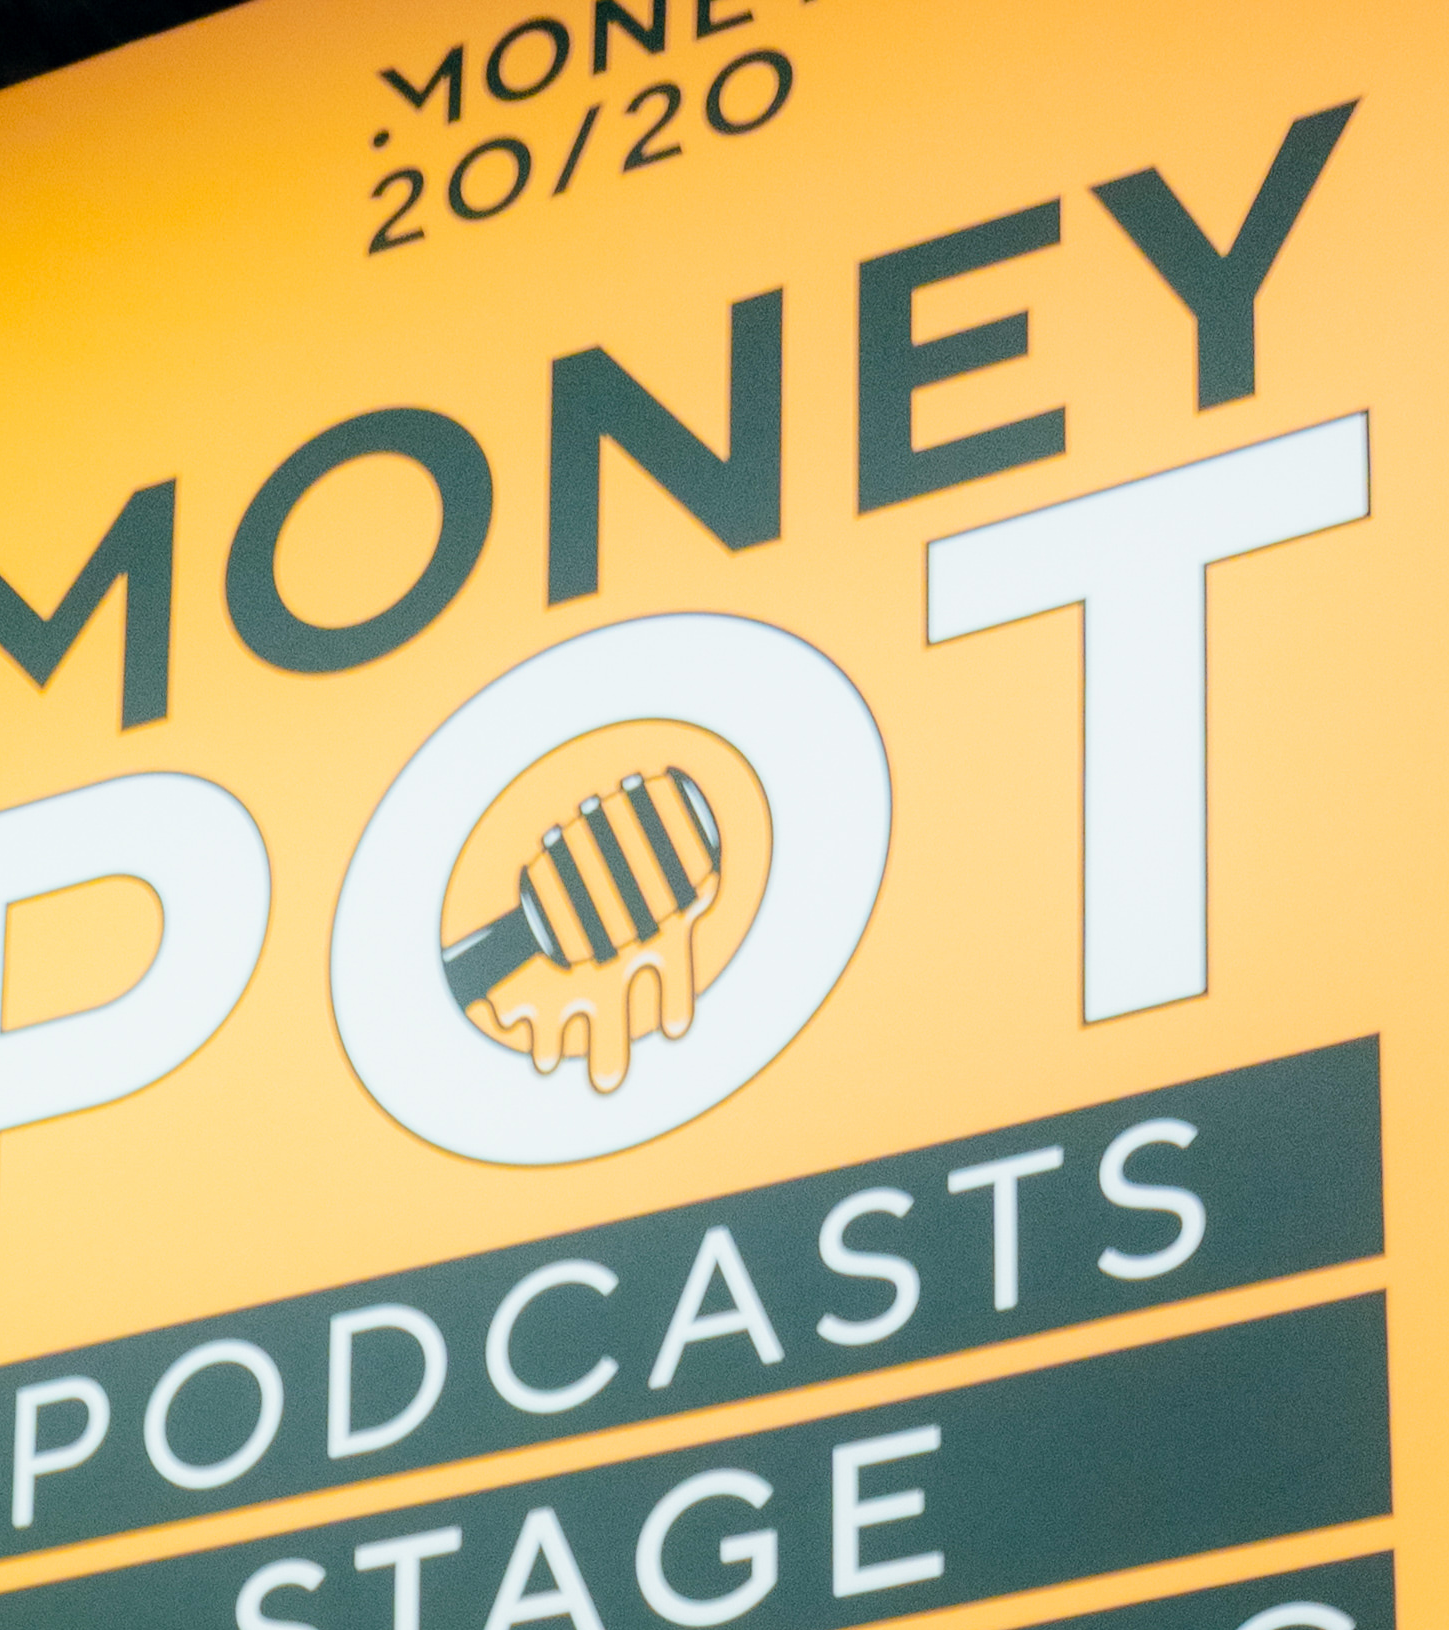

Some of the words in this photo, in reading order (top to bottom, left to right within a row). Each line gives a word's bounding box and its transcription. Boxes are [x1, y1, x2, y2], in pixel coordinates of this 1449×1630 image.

[366, 48, 794, 256] 20/20
[372, 0, 817, 148] MONE
[10, 1116, 1207, 1530] PODCASTS
